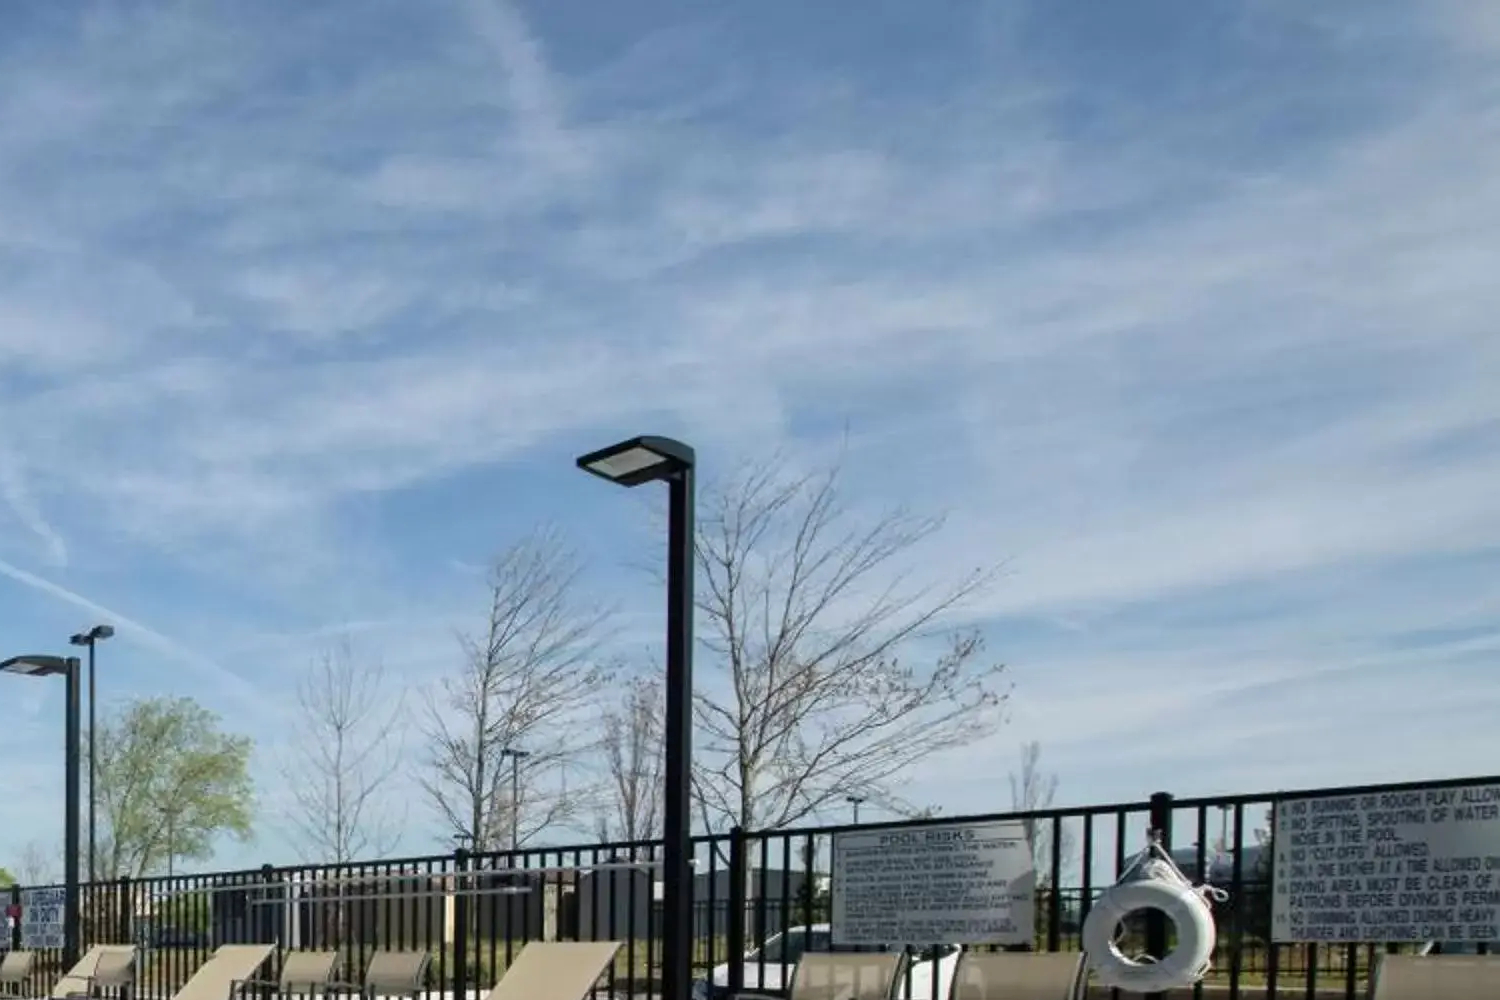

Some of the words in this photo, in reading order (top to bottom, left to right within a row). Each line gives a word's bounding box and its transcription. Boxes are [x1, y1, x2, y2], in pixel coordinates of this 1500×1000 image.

[1381, 793, 1420, 810] ROUGH
[1426, 790, 1456, 806] PLAY
[1430, 807, 1448, 823] OF
[1454, 804, 1498, 822] WATER
[1341, 828, 1362, 844] THE
[1405, 876, 1421, 891] BE
[1428, 874, 1469, 890] CLEAR
[1475, 873, 1492, 889] OF
[1347, 892, 1394, 908] BEFORE
[1459, 907, 1496, 922] HEAVY
